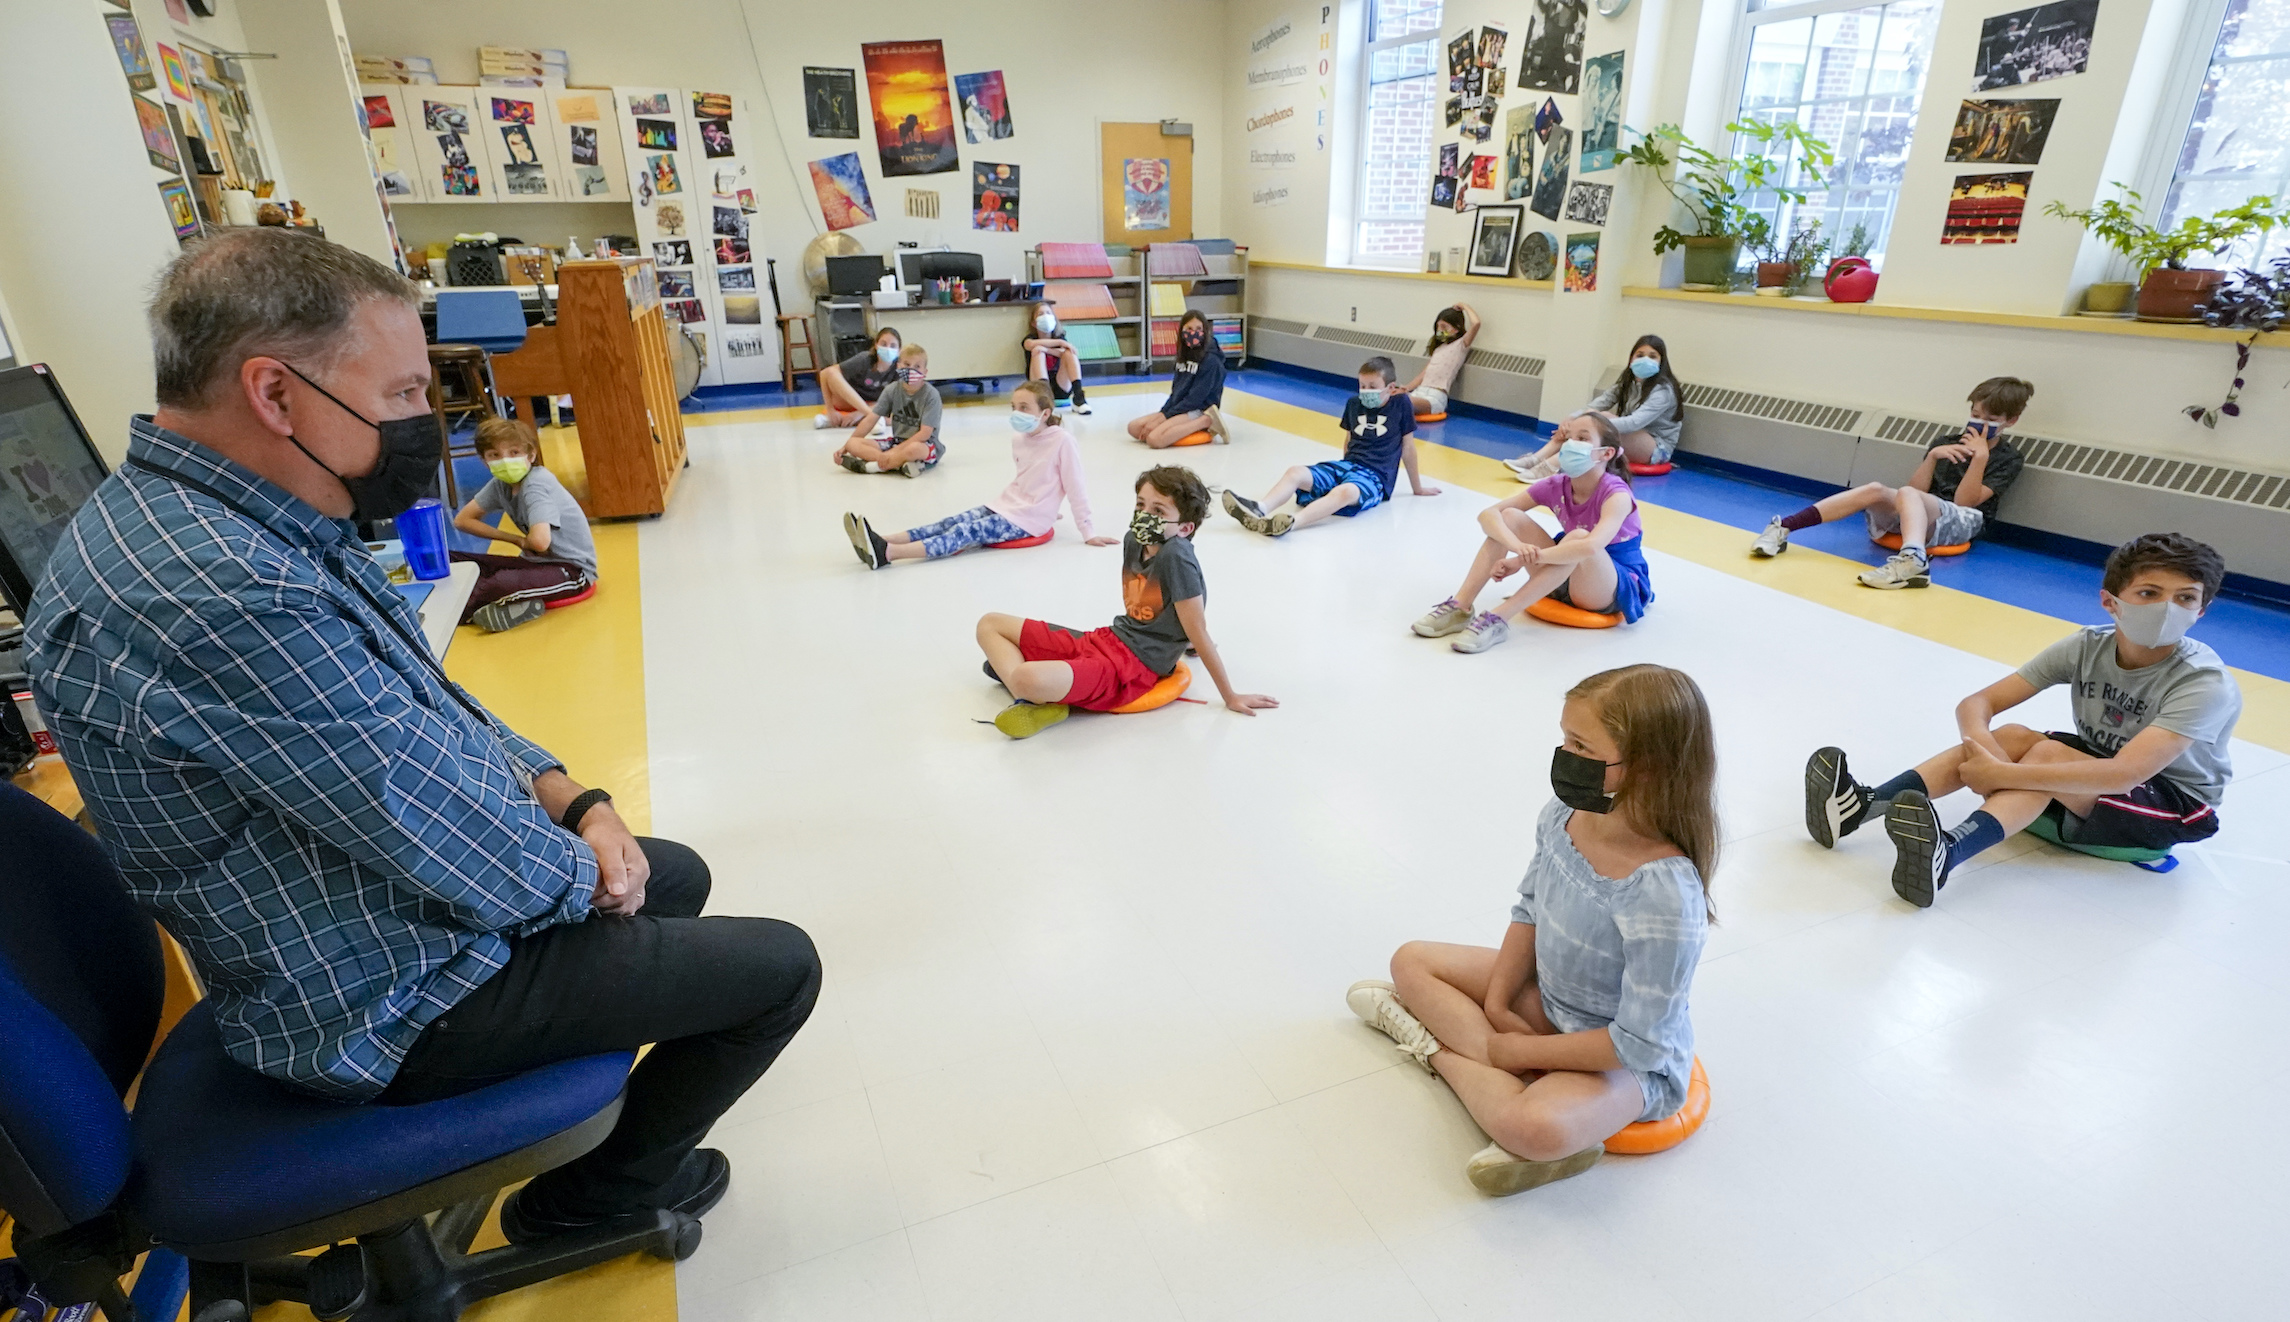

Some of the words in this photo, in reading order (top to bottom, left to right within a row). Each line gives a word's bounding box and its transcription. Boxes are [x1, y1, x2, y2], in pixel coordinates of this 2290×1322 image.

[1251, 23, 1291, 53] Aerophones
[1247, 64, 1307, 84] Membranophones
[1246, 106, 1294, 132] Chordophones
[1250, 150, 1296, 167] Electrophones
[1252, 187, 1288, 205] Idiophones
